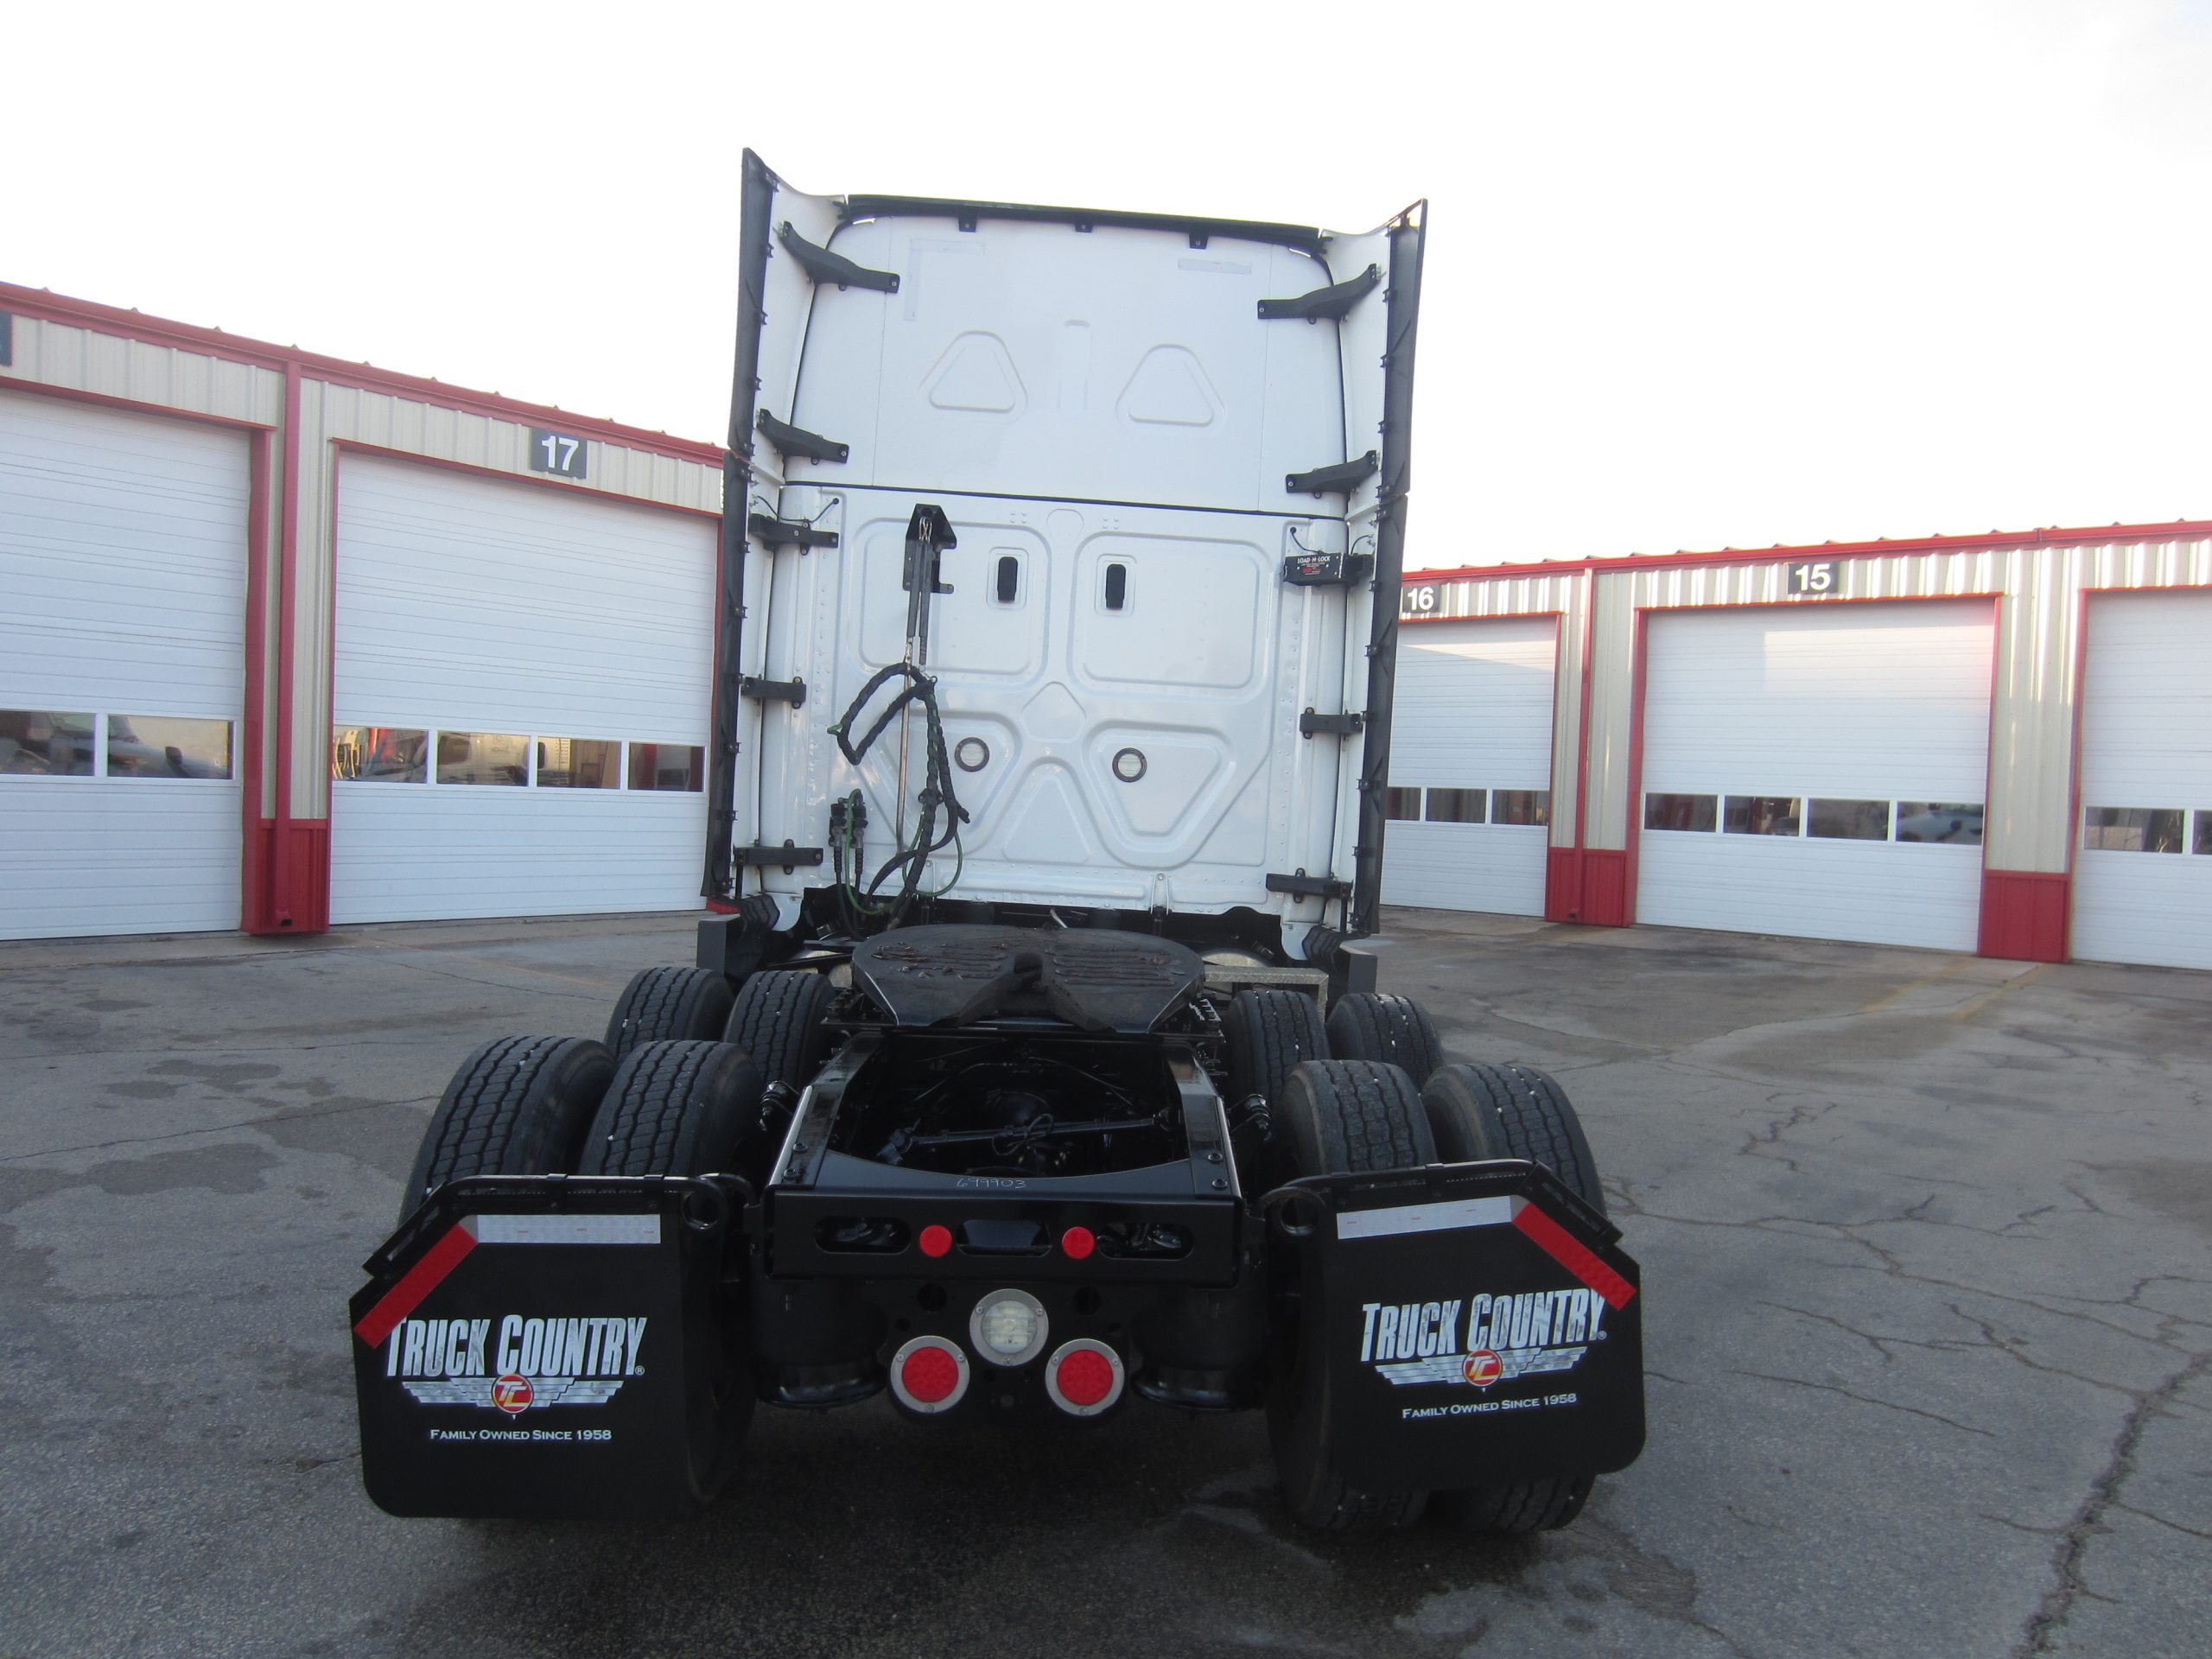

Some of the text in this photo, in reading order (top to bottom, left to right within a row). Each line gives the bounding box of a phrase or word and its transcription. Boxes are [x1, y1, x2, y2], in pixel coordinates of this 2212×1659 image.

[541, 435, 579, 472] 17
[1795, 563, 1831, 591] 15
[1407, 587, 1434, 611] 16
[1360, 1287, 1606, 1362] TRUCK COUNTRY
[387, 1313, 647, 1376] TRUCK COUNTRY
[1402, 1393, 1577, 1419] FAMILY OWNED SINCE 1958
[430, 1429, 612, 1440] FAMILY OWNED SINCE 1958
